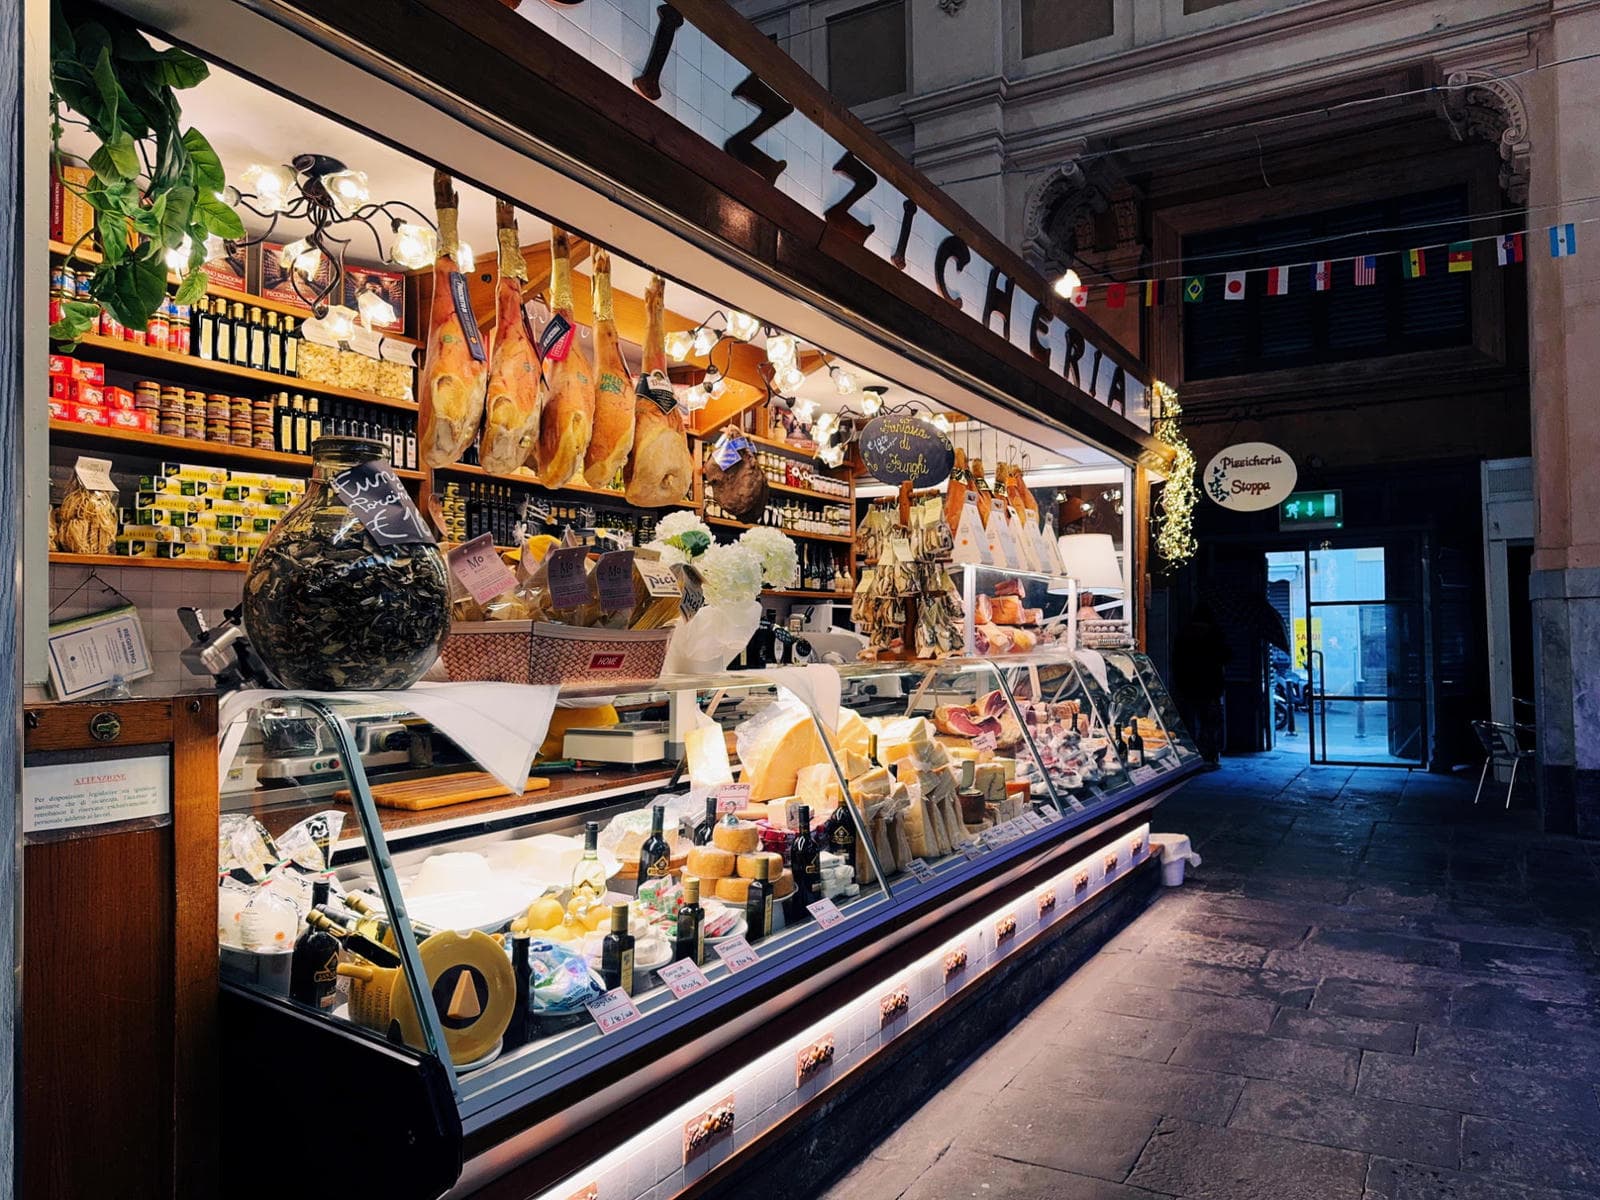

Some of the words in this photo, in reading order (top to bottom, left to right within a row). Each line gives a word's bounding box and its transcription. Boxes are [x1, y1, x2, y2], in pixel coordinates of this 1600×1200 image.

[505, 0, 1127, 417] IZZICHERIA
[899, 433, 911, 451] di
[886, 453, 930, 481] Funghi
[1219, 454, 1283, 471] Pizzicheria
[1230, 479, 1272, 496] Stoppa
[643, 572, 677, 589] Pici
[1296, 633, 1321, 641] SADI
[122, 628, 137, 665] REGISTRO
[597, 656, 619, 666] HOME
[74, 774, 127, 785] ATTENZIONE
